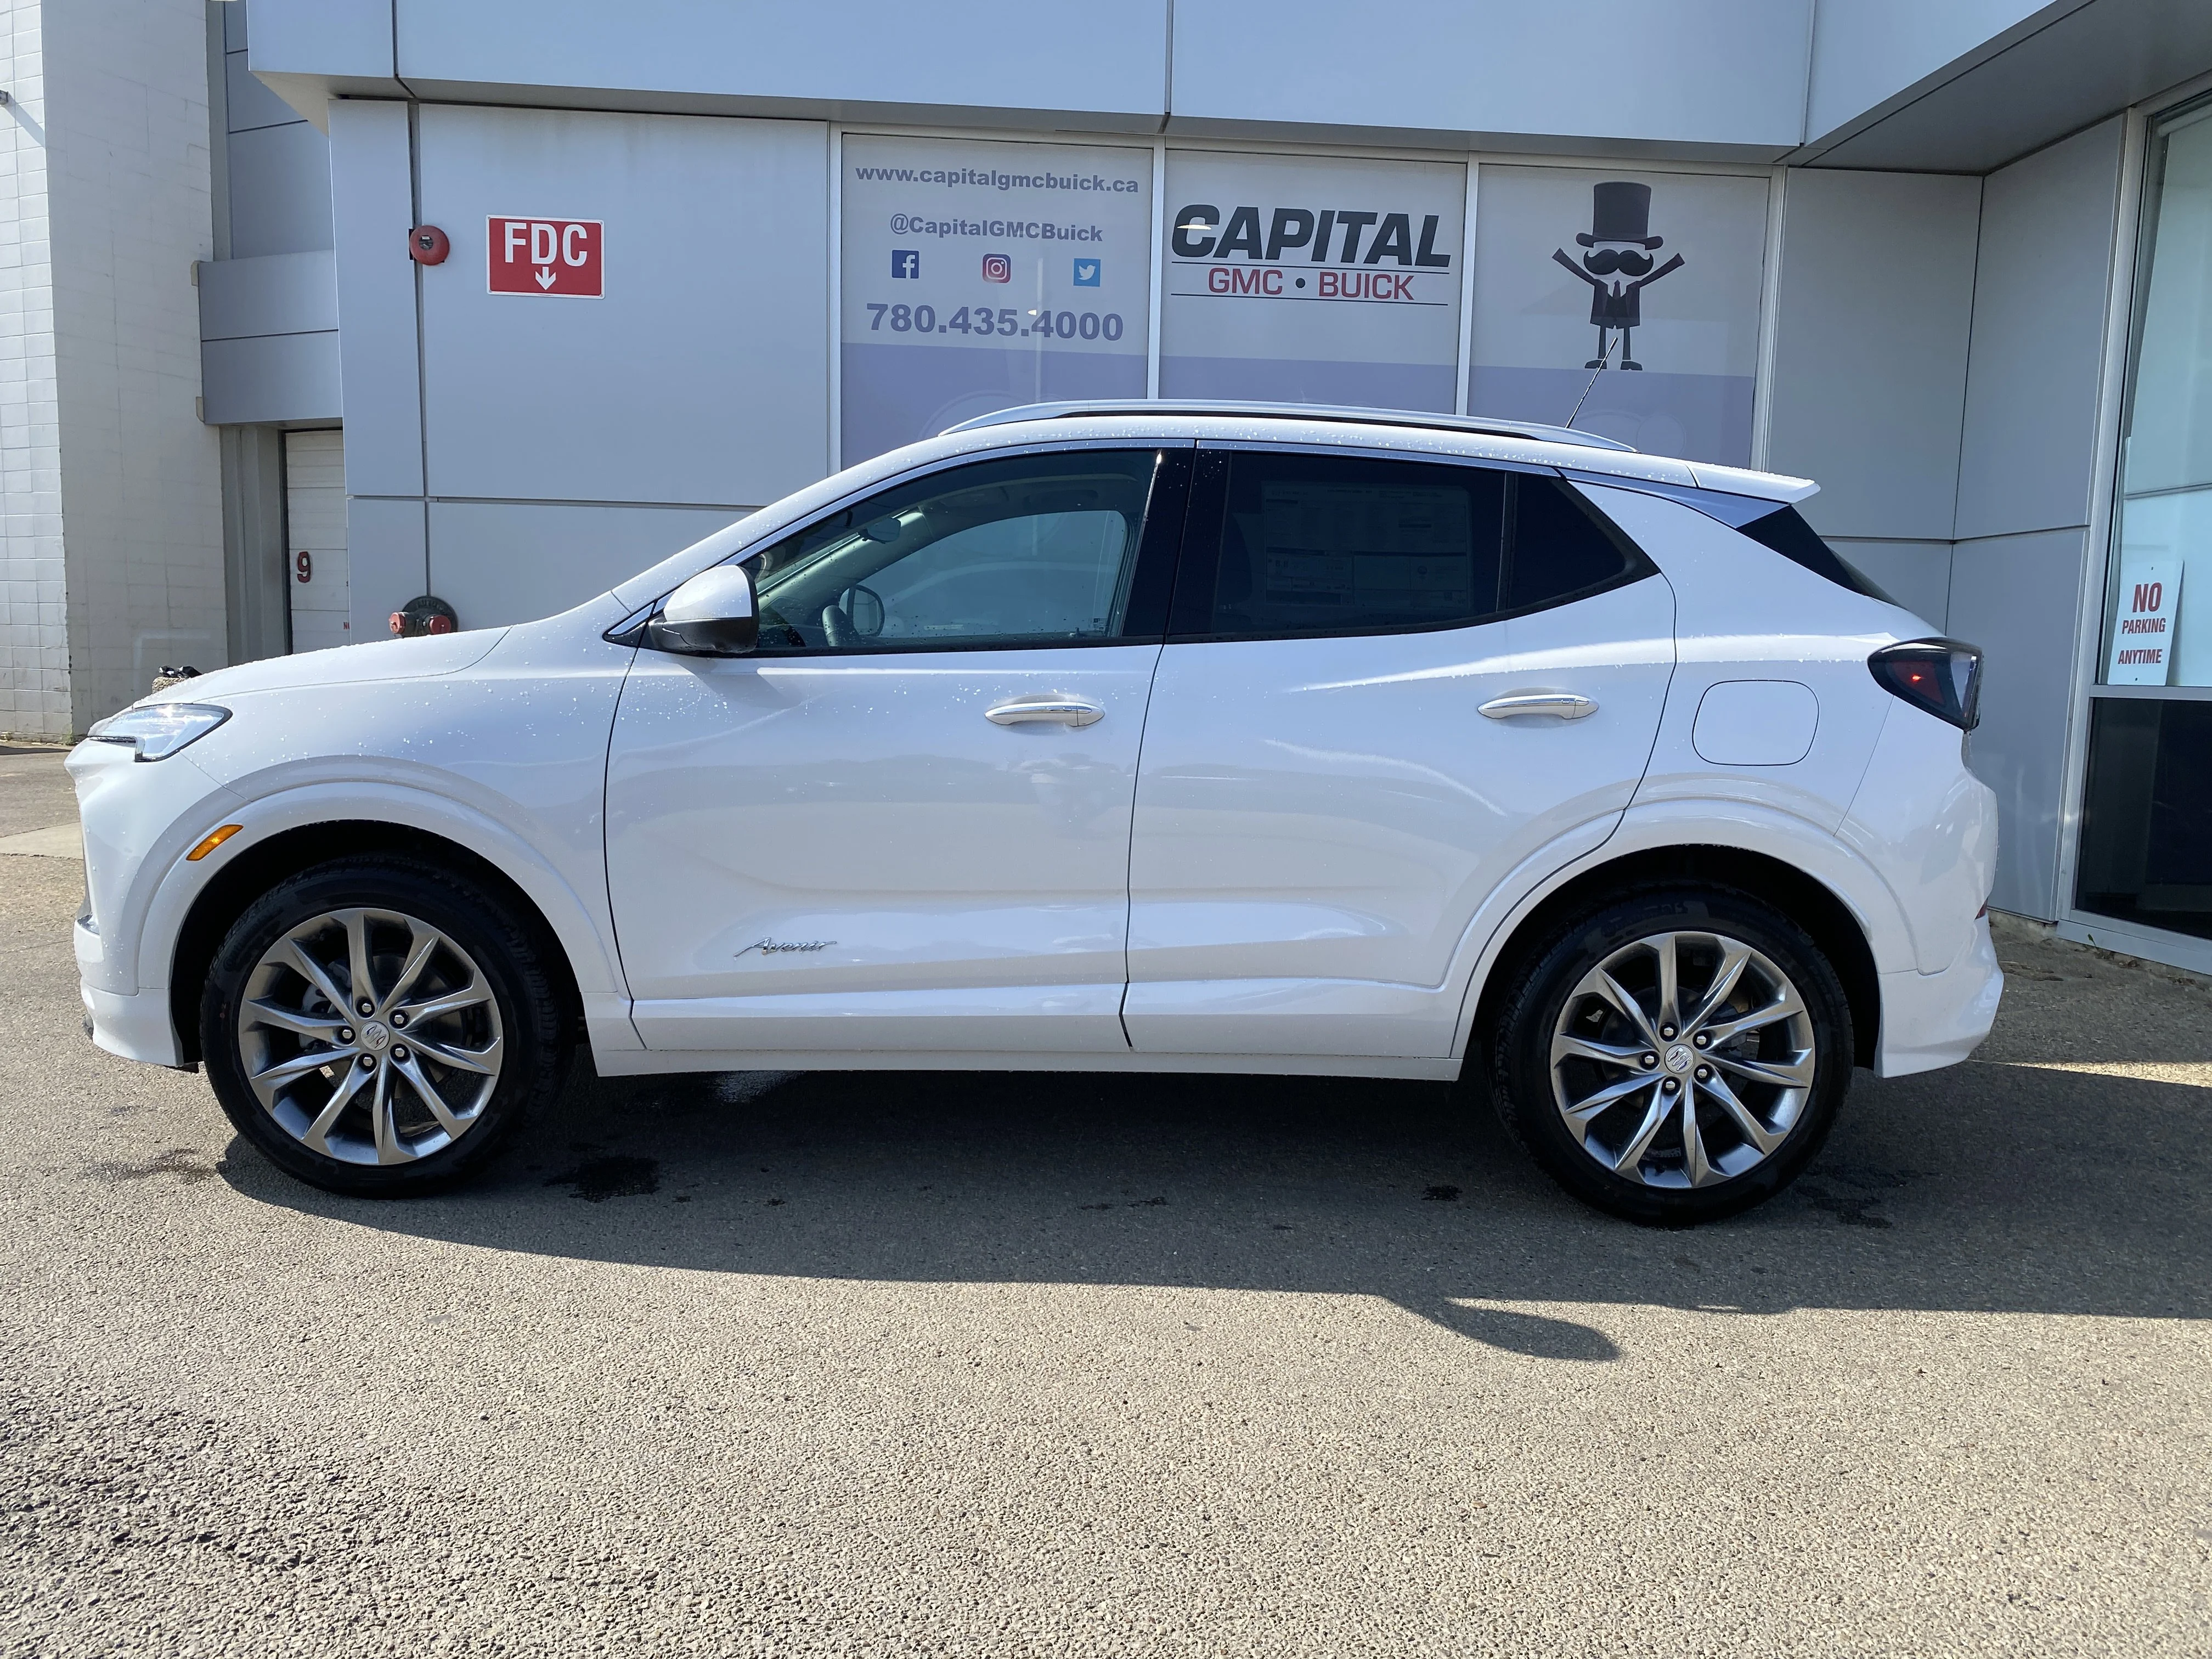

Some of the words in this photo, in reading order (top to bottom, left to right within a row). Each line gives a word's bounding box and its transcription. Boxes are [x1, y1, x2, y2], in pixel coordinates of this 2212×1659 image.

[856, 168, 1138, 193] www.capitalgmcbuick.ca
[890, 213, 1103, 241] @CapitalGMCBuick
[1172, 205, 1451, 267] CAPITAL
[504, 222, 588, 267] FDC
[1208, 267, 1283, 295] GMC
[1319, 272, 1414, 300] BUICK
[867, 303, 1124, 341] 780.435.4000
[297, 551, 311, 583] 9
[2133, 583, 2162, 612] NO
[2122, 618, 2166, 634] PARKING
[2118, 649, 2162, 664] ANYTIME
[733, 937, 837, 957] Avenir
